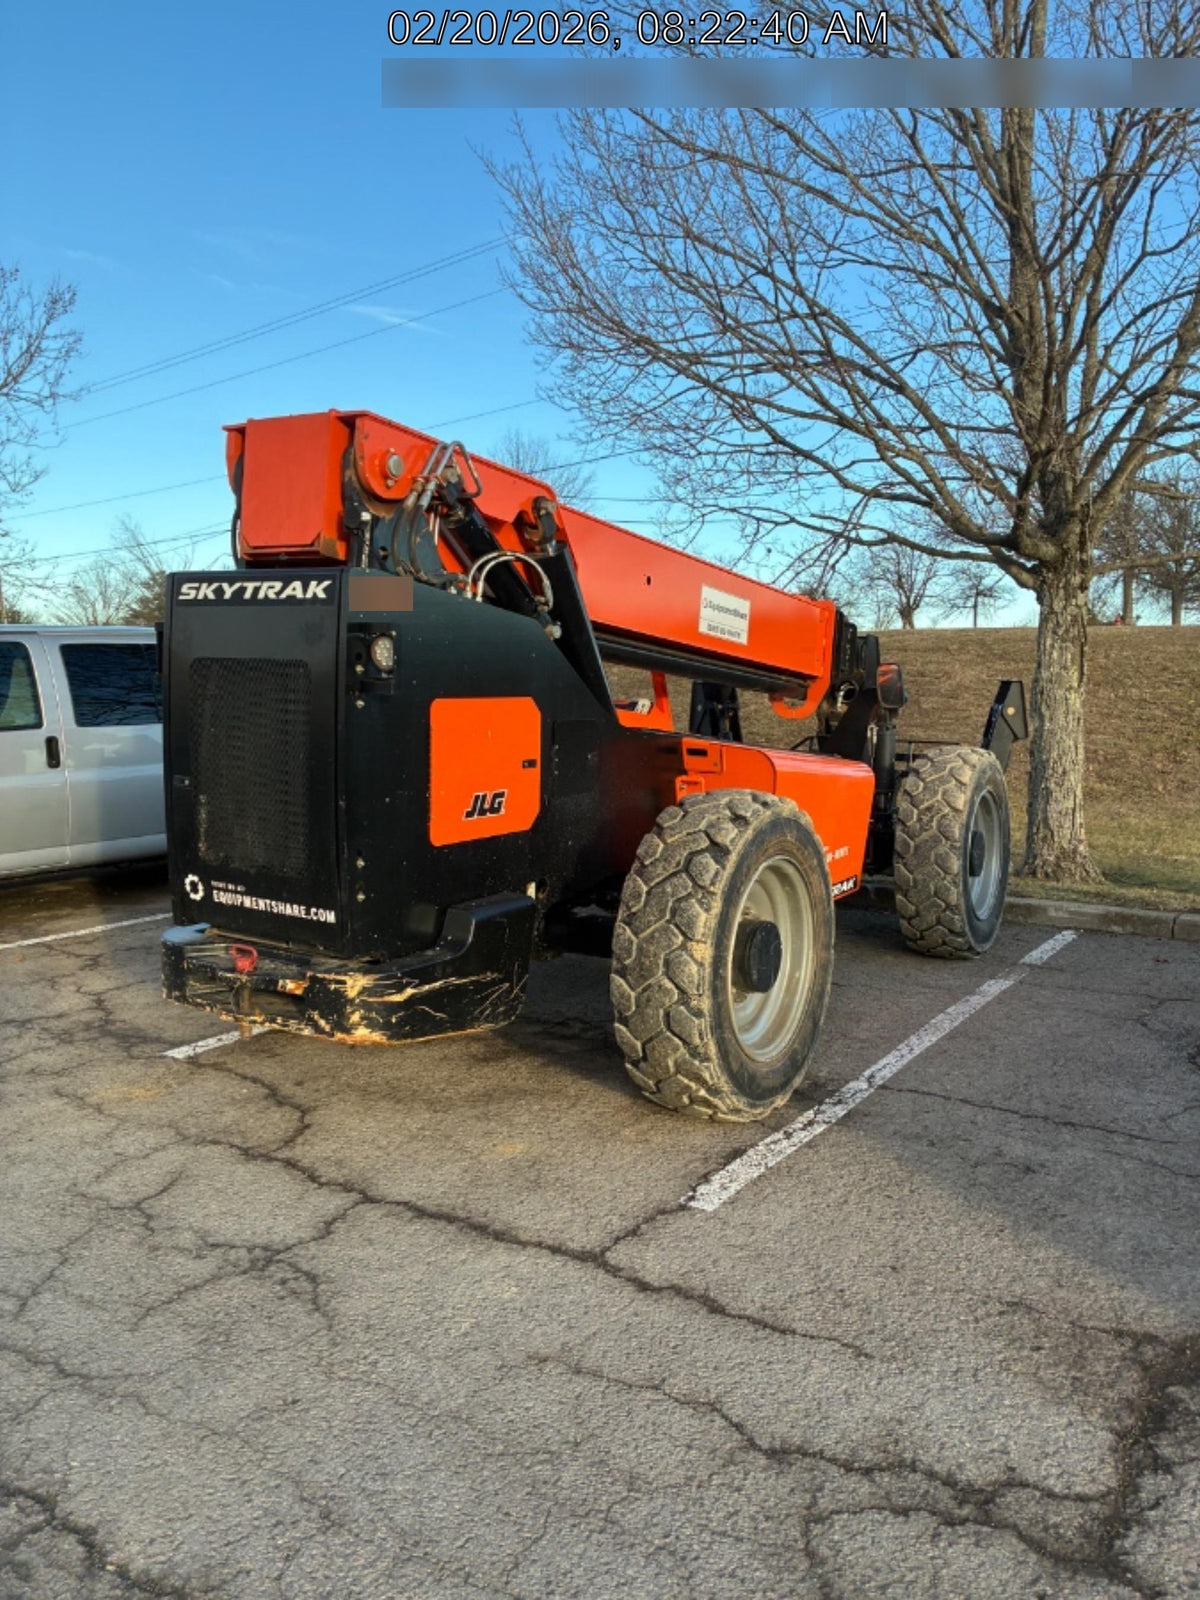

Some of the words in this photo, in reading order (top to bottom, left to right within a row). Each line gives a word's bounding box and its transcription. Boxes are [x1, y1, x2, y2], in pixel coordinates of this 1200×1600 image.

[178, 580, 333, 600] SKYTRAK
[463, 789, 507, 821] JLG
[212, 890, 337, 923] EQUIPMENTSHARE.COM
